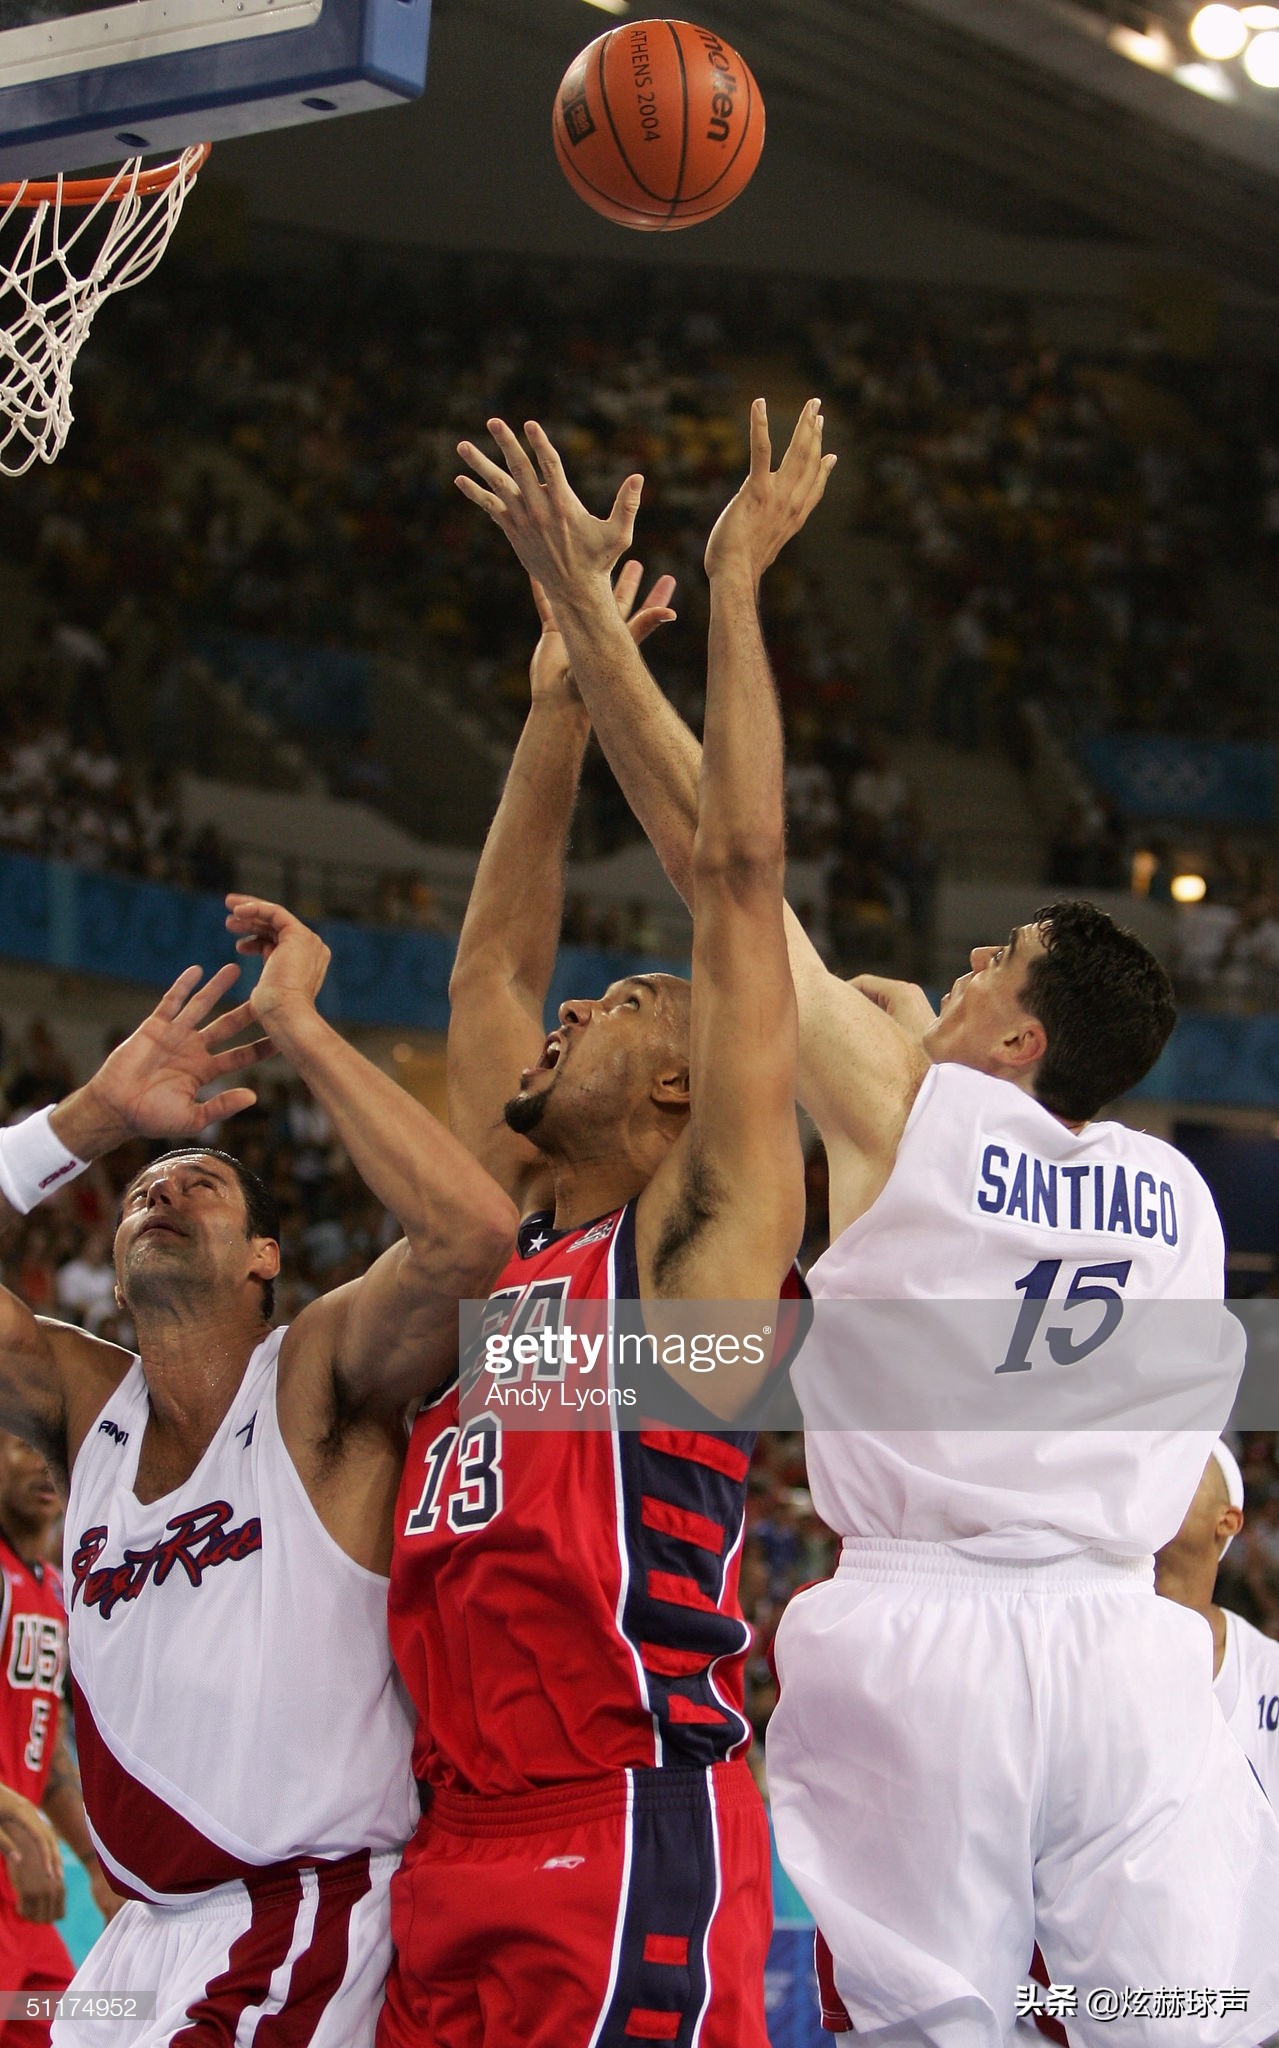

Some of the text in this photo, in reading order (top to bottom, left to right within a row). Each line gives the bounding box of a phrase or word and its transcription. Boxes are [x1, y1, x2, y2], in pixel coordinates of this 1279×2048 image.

[630, 30, 661, 142] ATHENS 2004
[694, 28, 738, 143] molten
[977, 1144, 1179, 1247] SANTIAGO
[421, 1275, 573, 1412] SA
[994, 1259, 1133, 1375] 15
[404, 1410, 504, 1537] 13
[24, 1697, 51, 1773] 5
[1257, 1694, 1279, 1732] 10
